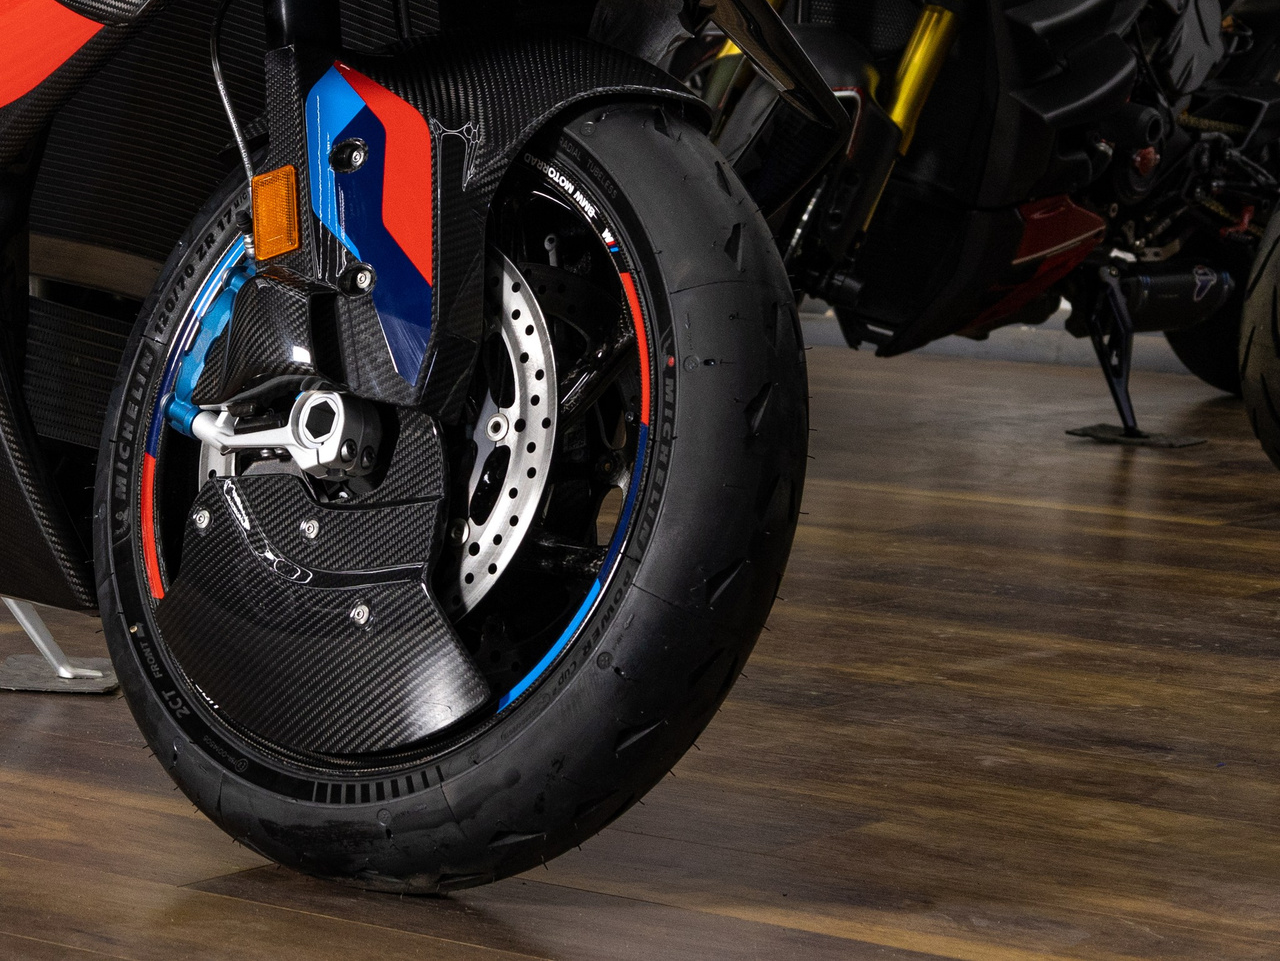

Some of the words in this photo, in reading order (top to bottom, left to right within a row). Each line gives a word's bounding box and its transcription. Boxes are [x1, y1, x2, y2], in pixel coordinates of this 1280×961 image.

[524, 153, 575, 195] MOTORRAD
[586, 158, 618, 199] TUBELESS
[573, 190, 596, 217] BMW
[154, 264, 195, 334] 120/70
[195, 231, 215, 261] ZR
[217, 208, 233, 230] 17
[114, 346, 156, 501] MICHELIN
[637, 377, 674, 554] MICHELIN
[582, 570, 631, 658] POWER
[140, 641, 163, 679] FRONT
[161, 689, 191, 719] 2CT
